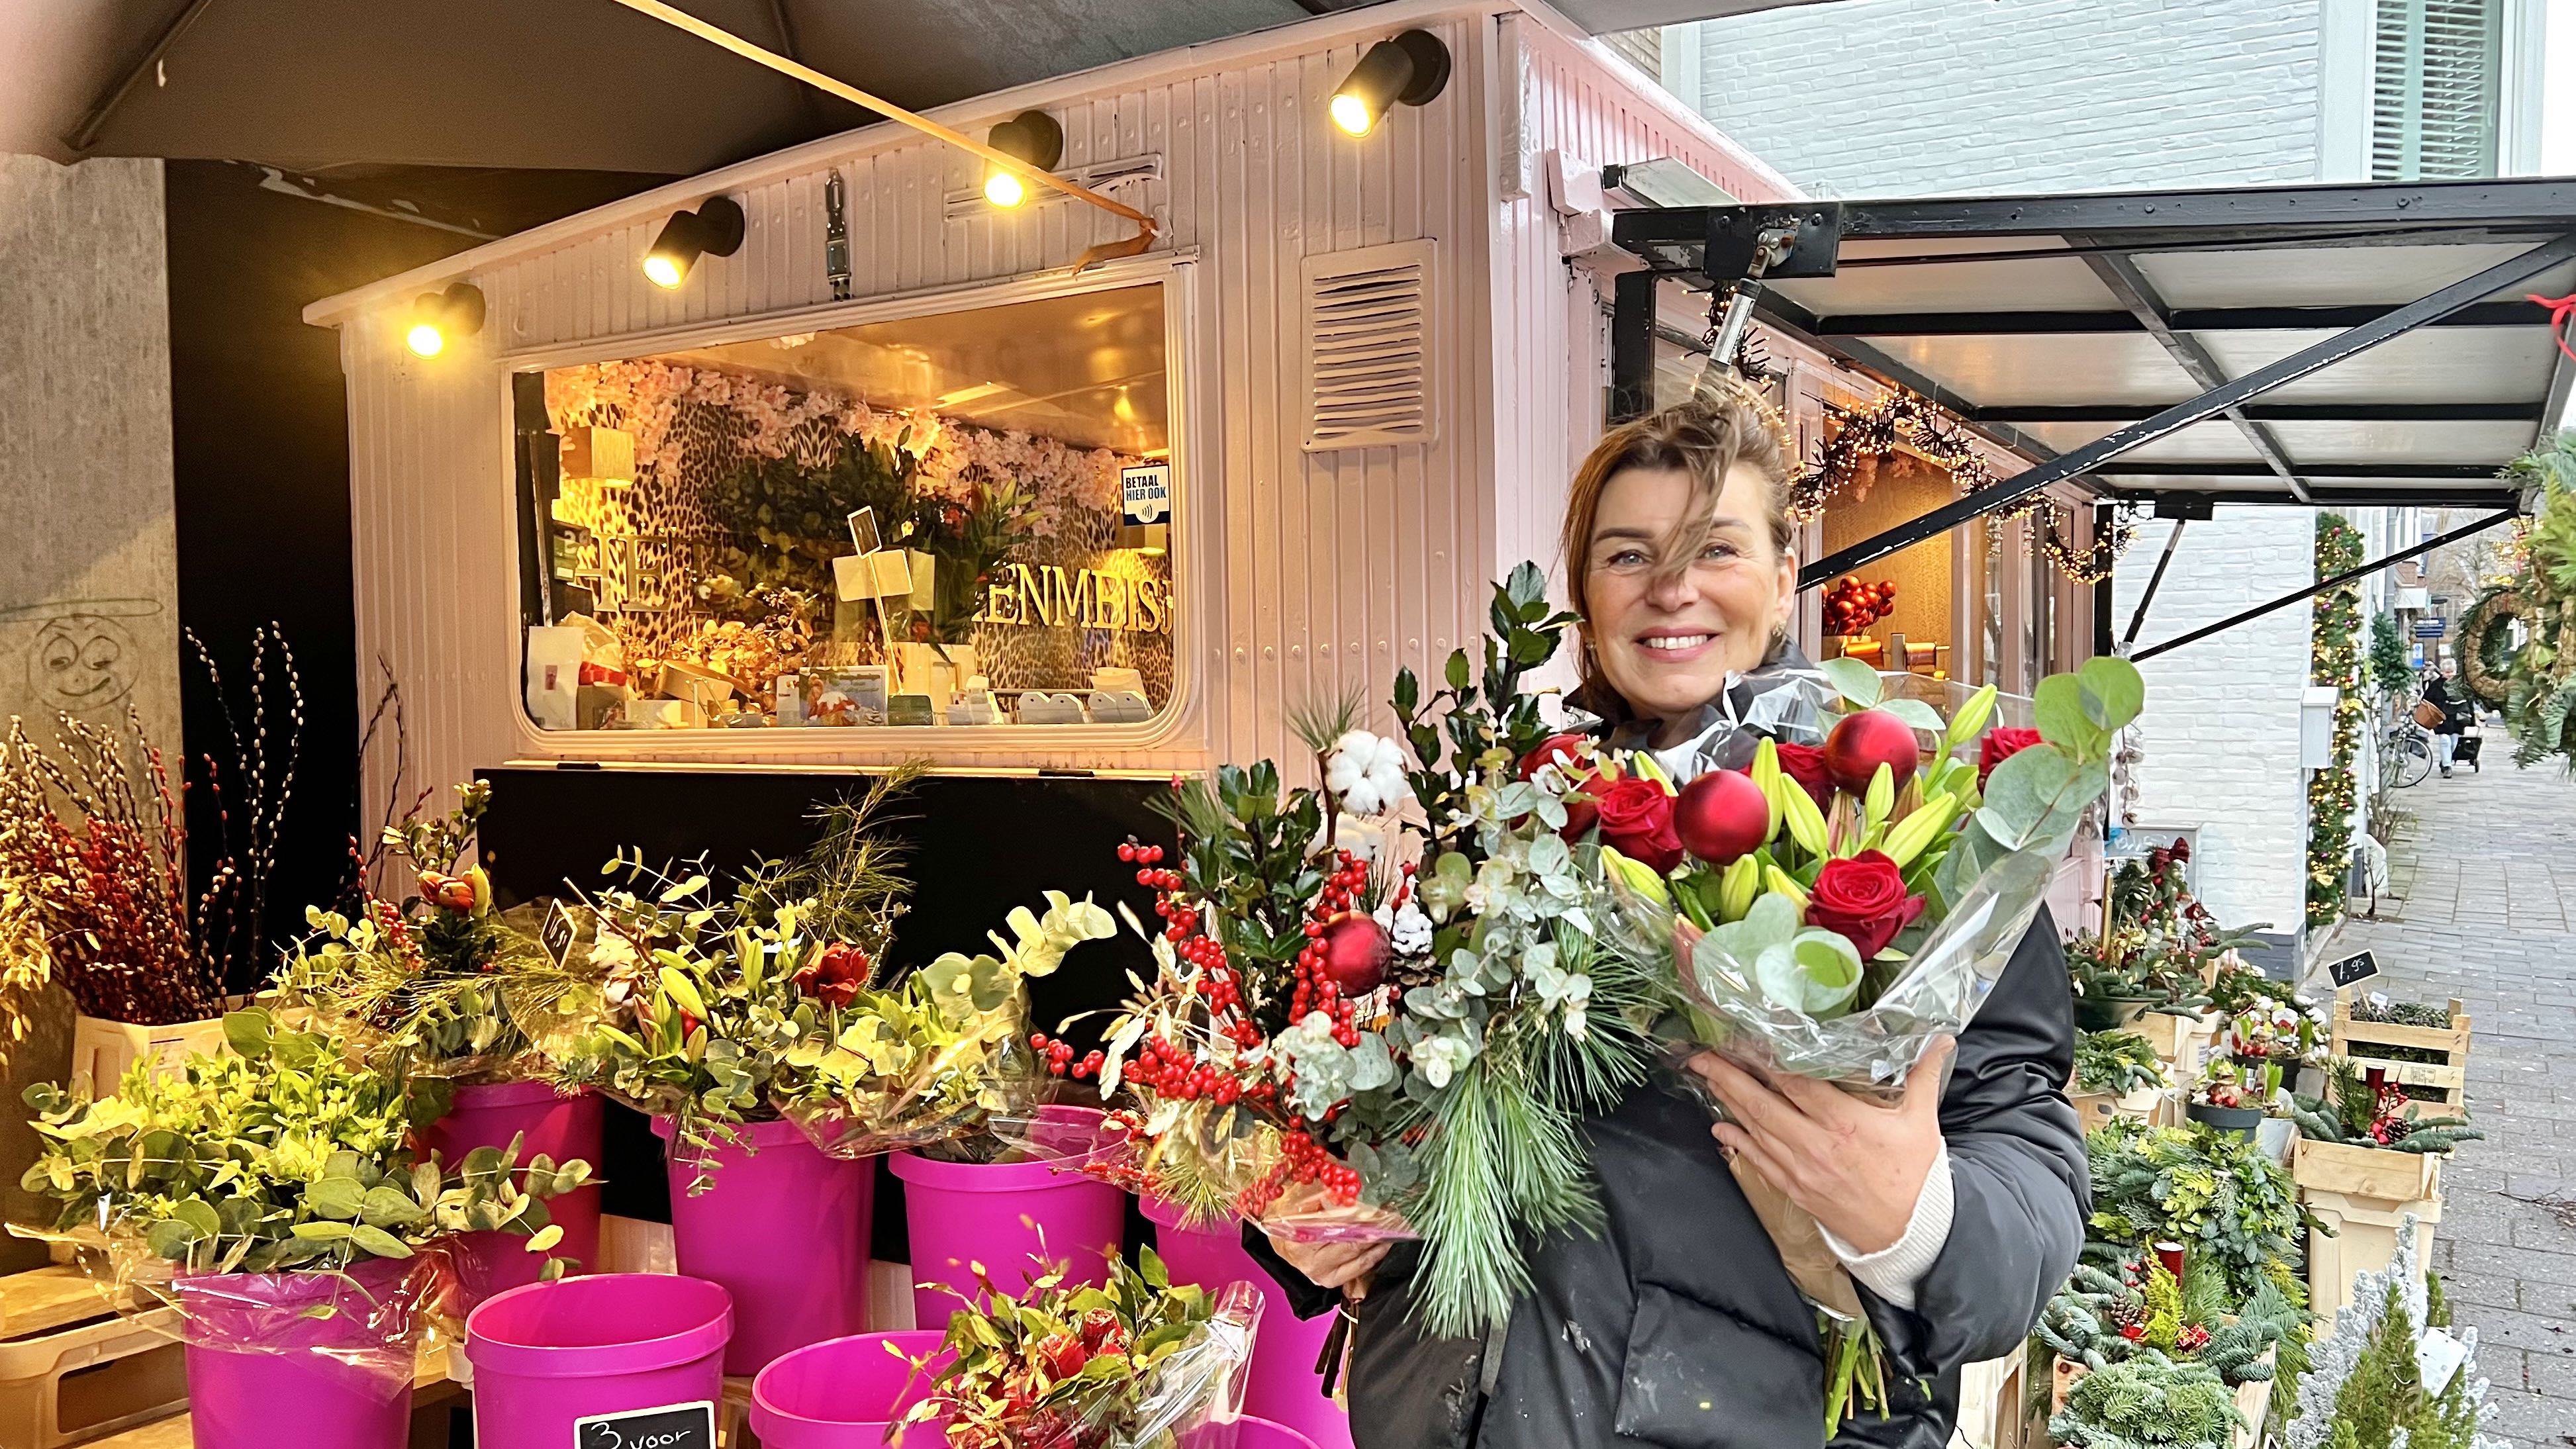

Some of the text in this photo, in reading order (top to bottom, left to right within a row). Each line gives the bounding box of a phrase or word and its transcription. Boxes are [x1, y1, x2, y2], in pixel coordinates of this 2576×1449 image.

[1125, 475, 1159, 489] BETAAL
[1126, 487, 1167, 501] HIER OOK
[630, 1430, 691, 1449] voor
